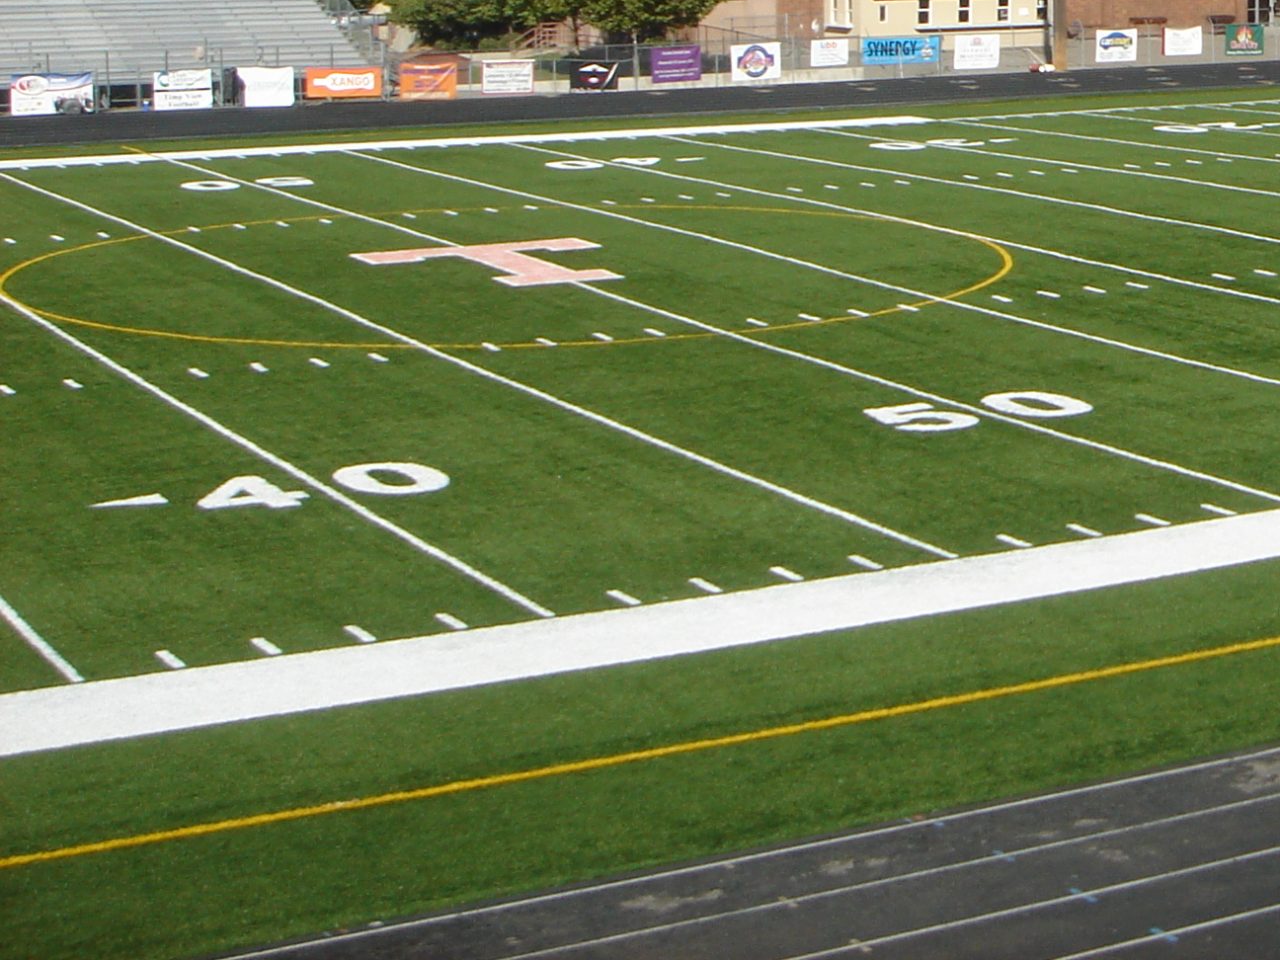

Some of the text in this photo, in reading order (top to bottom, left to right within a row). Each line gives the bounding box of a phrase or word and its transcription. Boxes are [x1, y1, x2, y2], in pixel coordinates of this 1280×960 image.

[866, 41, 918, 57] SYNERGY
[330, 73, 371, 87] XANGO
[545, 156, 661, 170] 40
[180, 176, 315, 191] 50
[863, 390, 1093, 433] 50
[197, 462, 450, 511] 40
